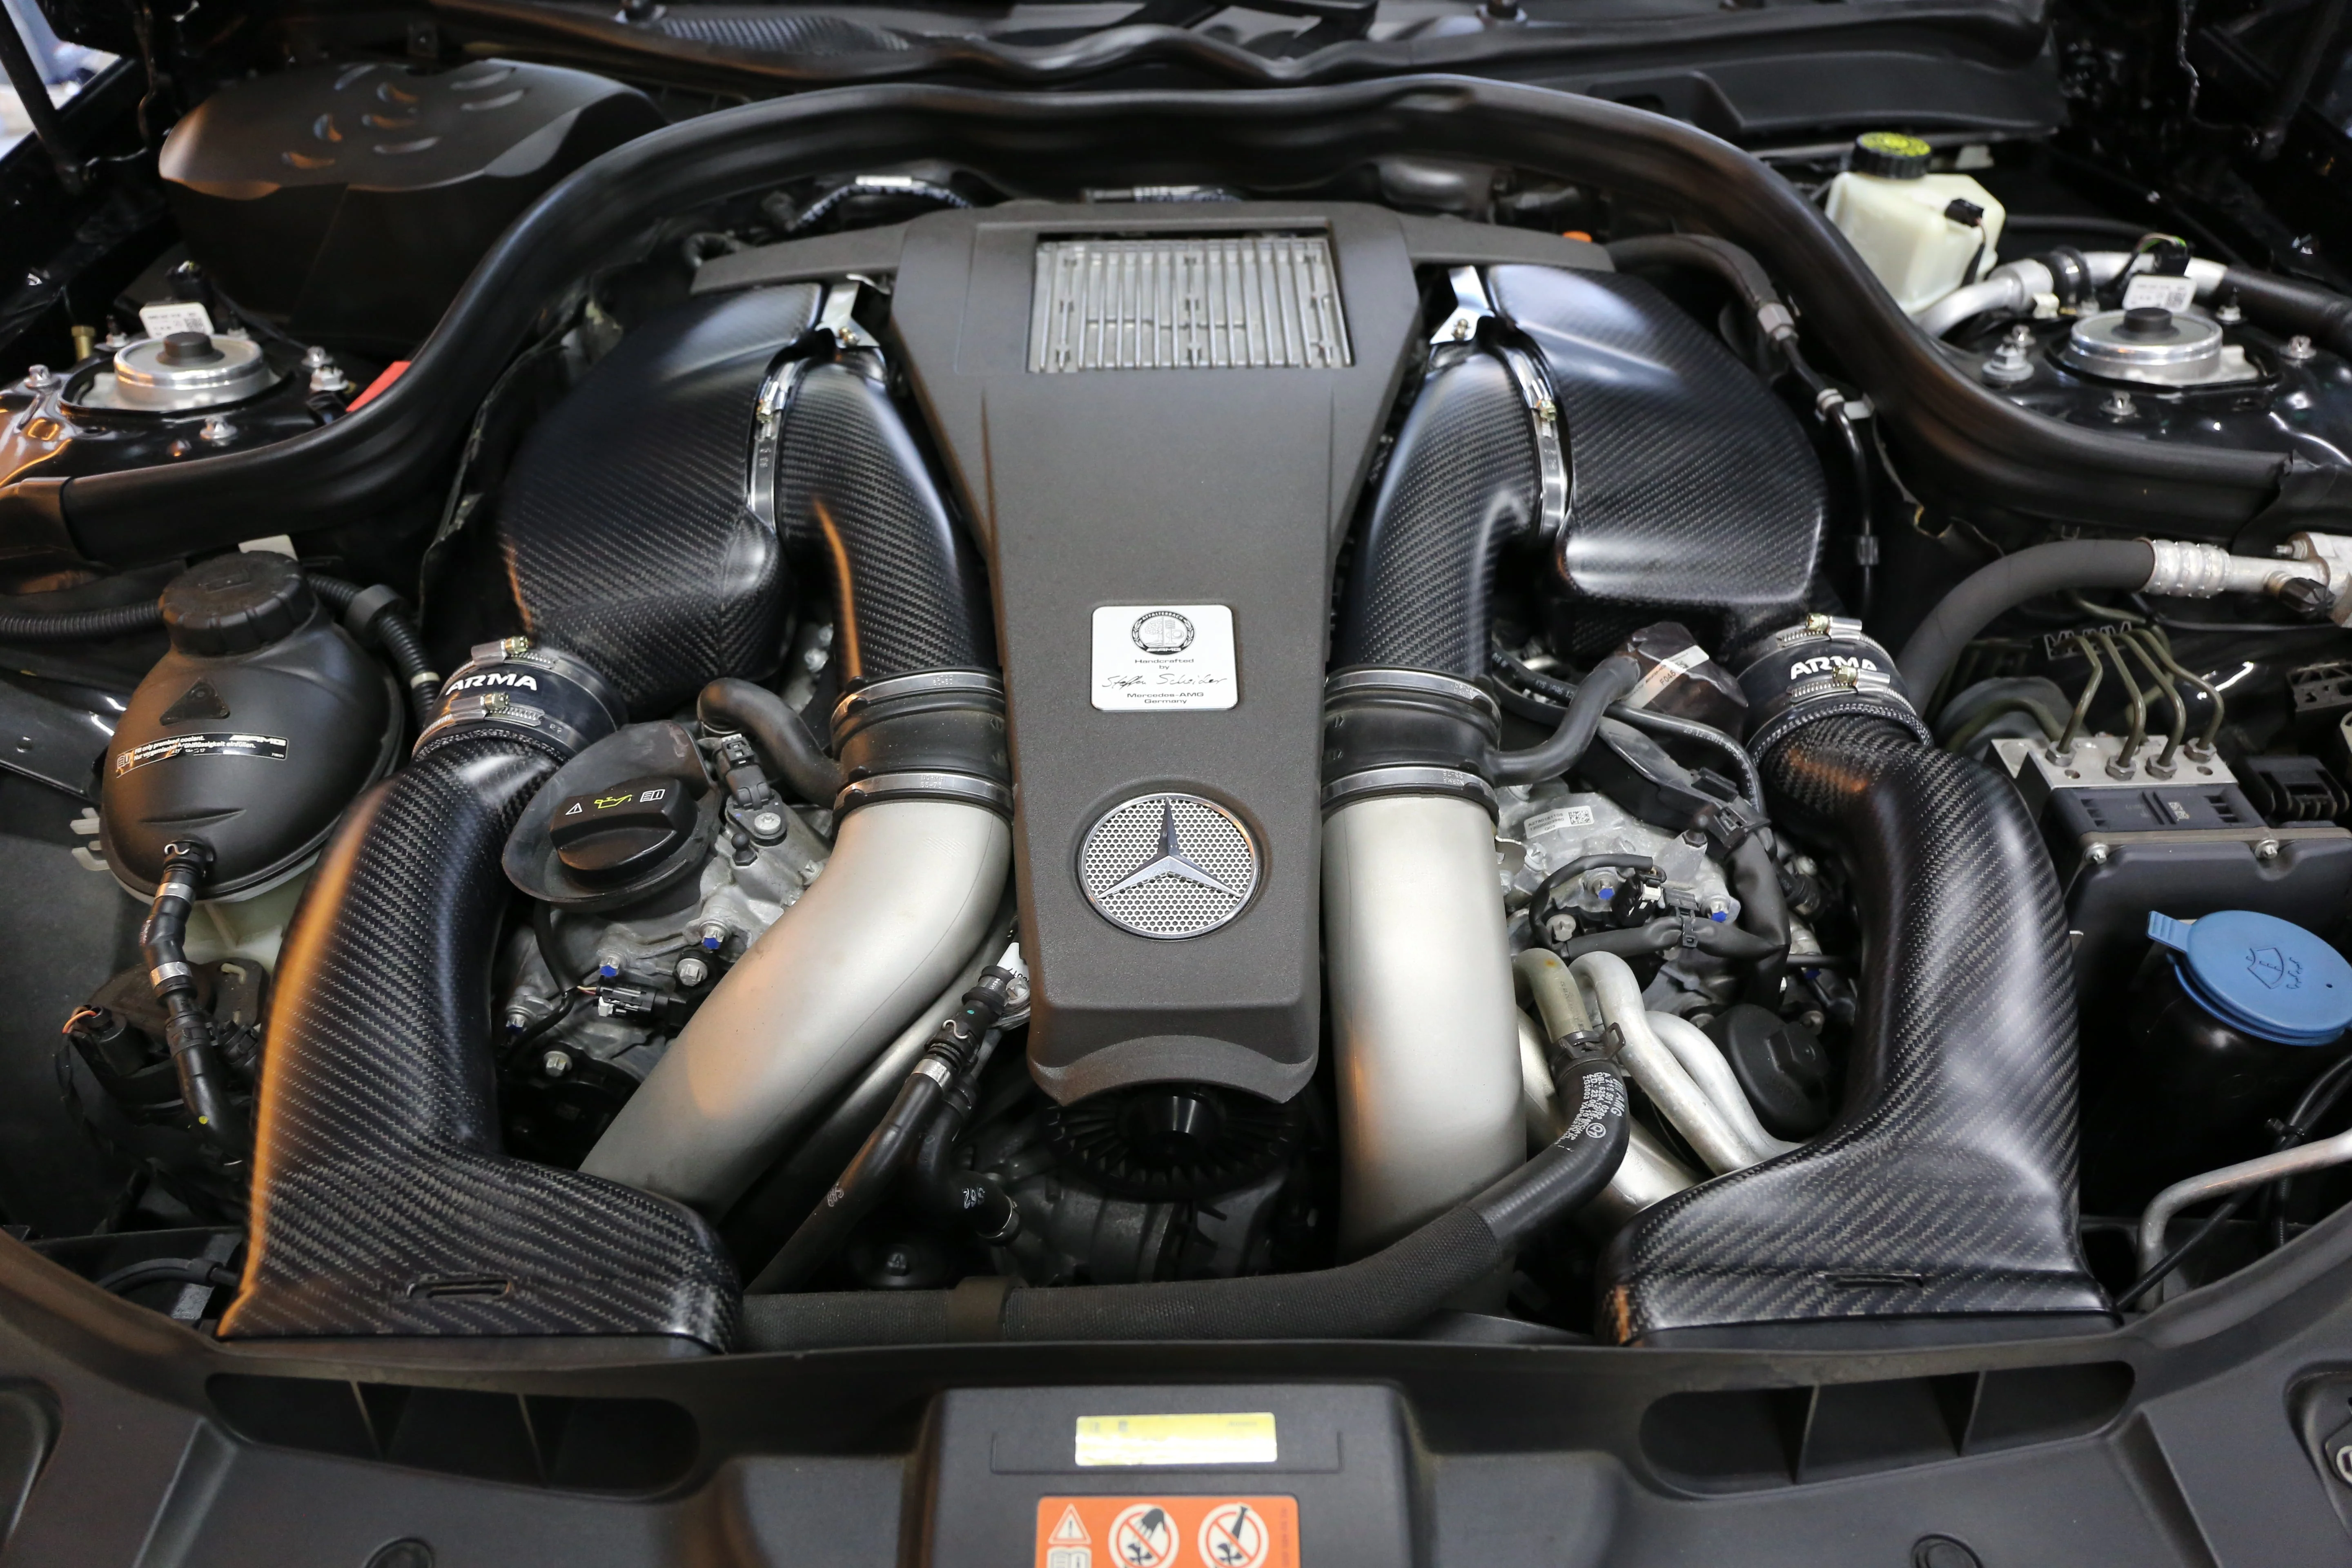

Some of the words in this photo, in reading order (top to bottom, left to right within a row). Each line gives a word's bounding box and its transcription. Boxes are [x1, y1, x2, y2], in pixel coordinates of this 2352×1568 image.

[1789, 655, 1878, 681] ARMA
[445, 673, 538, 696] ARMA
[1442, 777, 1465, 786] NORMA
[1582, 1075, 1591, 1100] ZGS003
[1594, 1072, 1605, 1085] DBL
[1582, 1089, 1599, 1117] 23.06.10
[1604, 1092, 1614, 1105] 501
[1596, 1104, 1609, 1120] 0282
